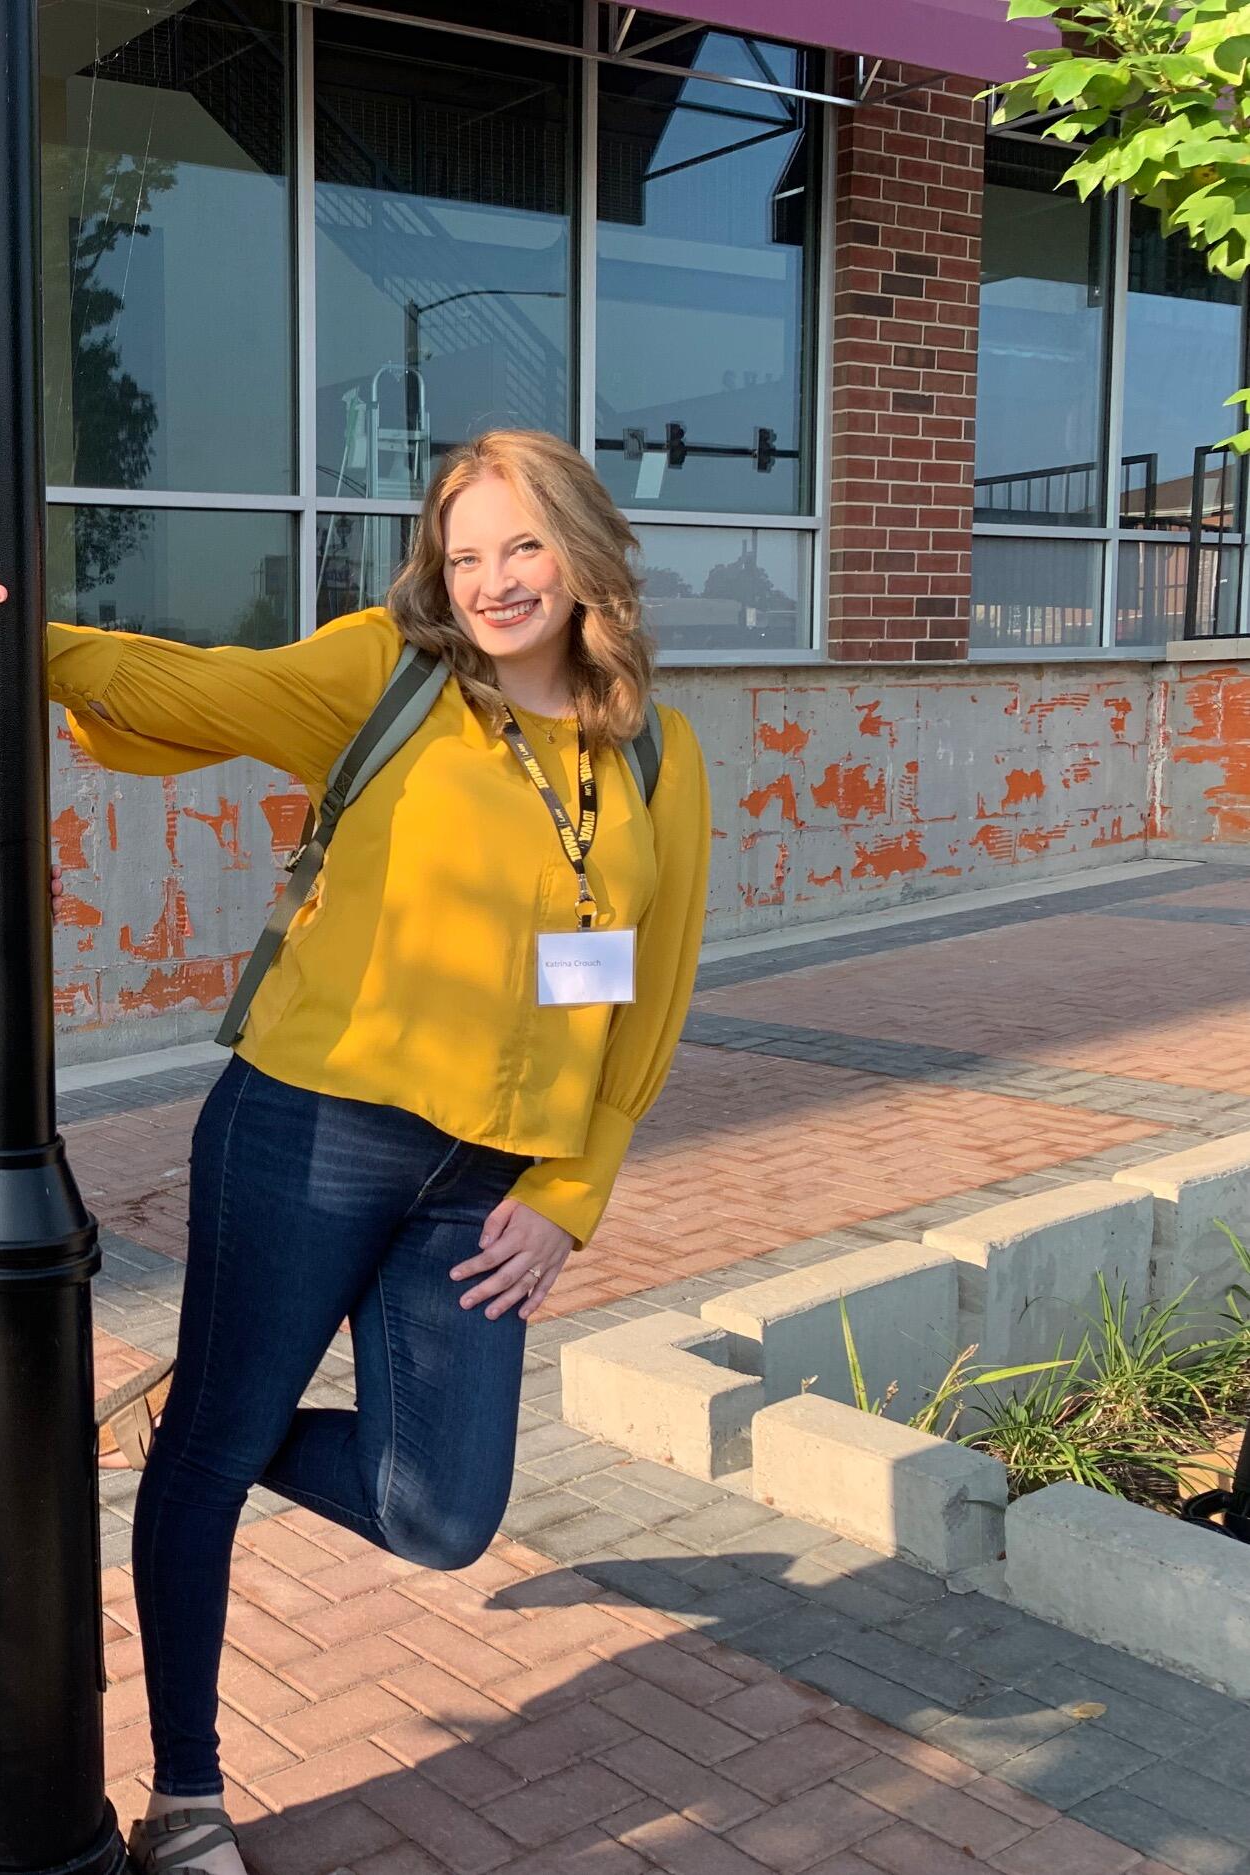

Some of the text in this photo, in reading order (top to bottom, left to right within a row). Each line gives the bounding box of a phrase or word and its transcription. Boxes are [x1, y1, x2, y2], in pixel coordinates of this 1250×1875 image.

[517, 743, 549, 789] IOWA LAW
[580, 750, 593, 782] IOWA
[554, 808, 582, 862] IOWA LAW
[578, 810, 595, 841] IOWA
[545, 959, 601, 968] Katrina Crouch
